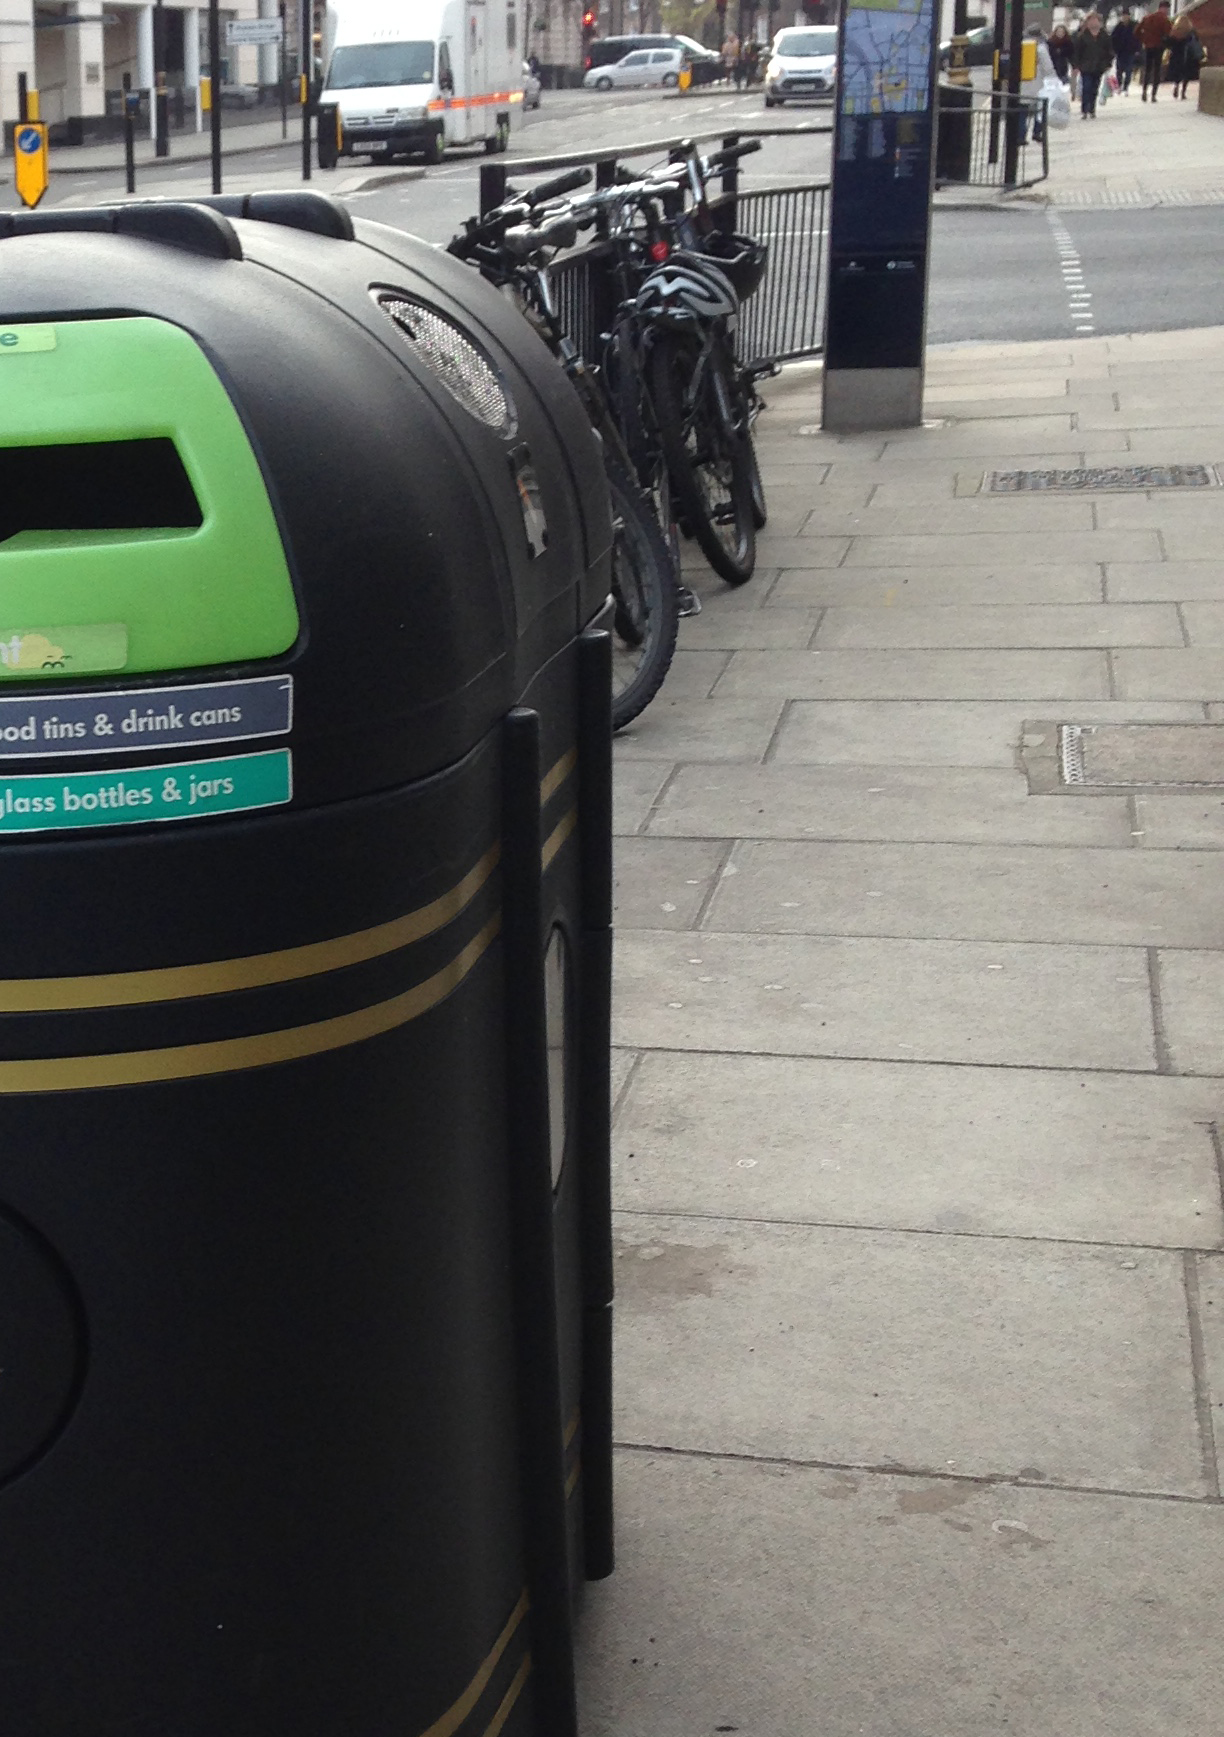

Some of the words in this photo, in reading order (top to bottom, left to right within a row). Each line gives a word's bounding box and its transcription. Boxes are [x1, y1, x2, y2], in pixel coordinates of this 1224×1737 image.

[43, 717, 87, 739] tins
[93, 713, 114, 736] &
[121, 705, 184, 733] drink
[189, 705, 242, 726] cans
[63, 783, 153, 811] bottles
[161, 777, 182, 802] &
[188, 774, 234, 805] jars
